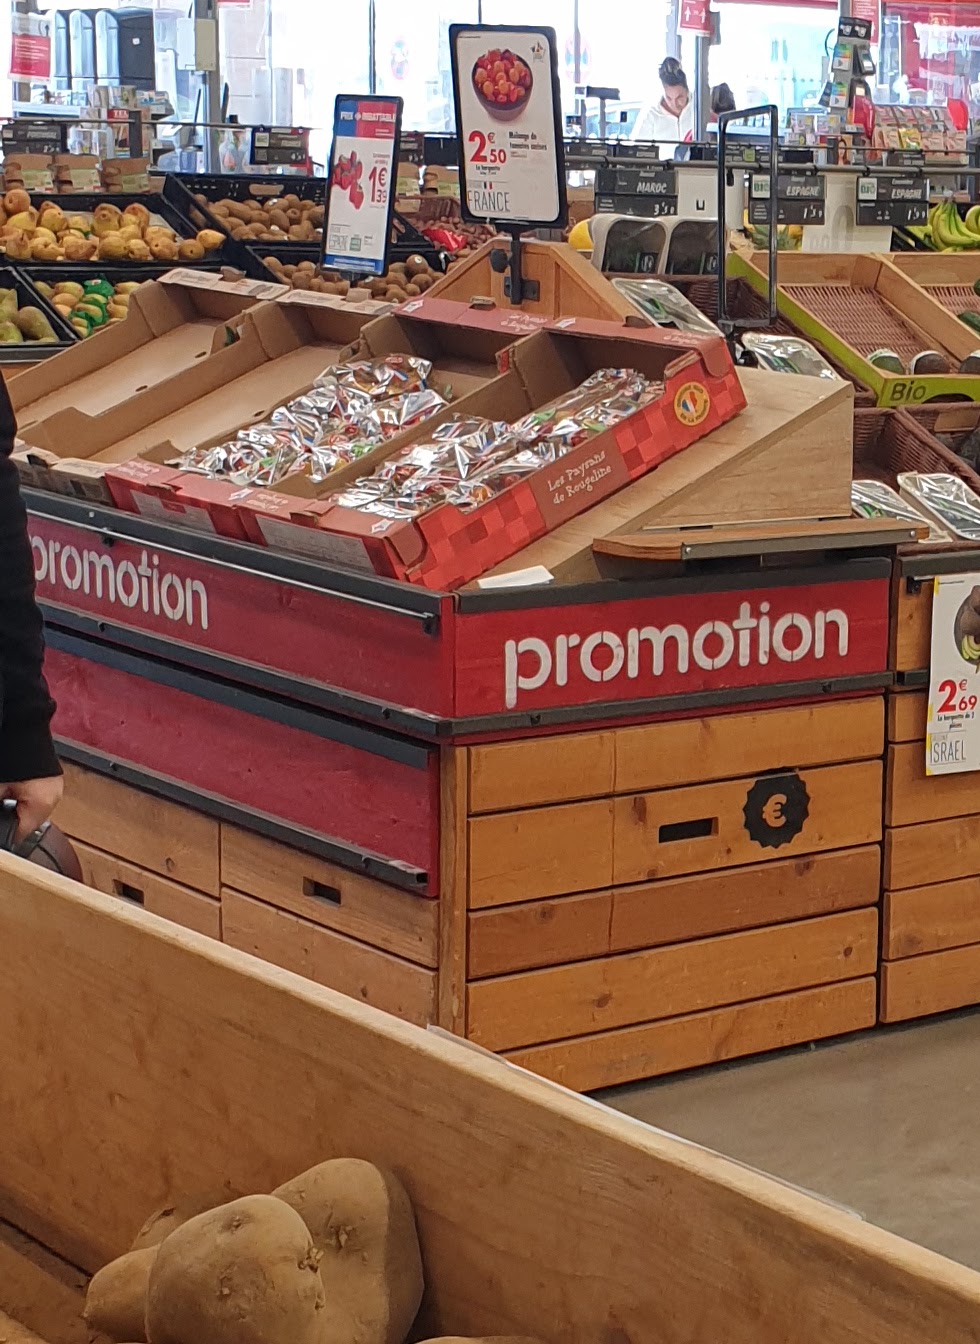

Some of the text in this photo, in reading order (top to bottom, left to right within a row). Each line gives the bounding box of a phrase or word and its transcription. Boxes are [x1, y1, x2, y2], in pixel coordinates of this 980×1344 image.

[636, 182, 667, 194] MAROC
[786, 186, 820, 197] ESPAGNE
[891, 189, 923, 199] ESPAGNE
[467, 190, 511, 213] FRANCE
[889, 381, 927, 402] Bio
[553, 492, 565, 505] de
[504, 601, 848, 708] promotion
